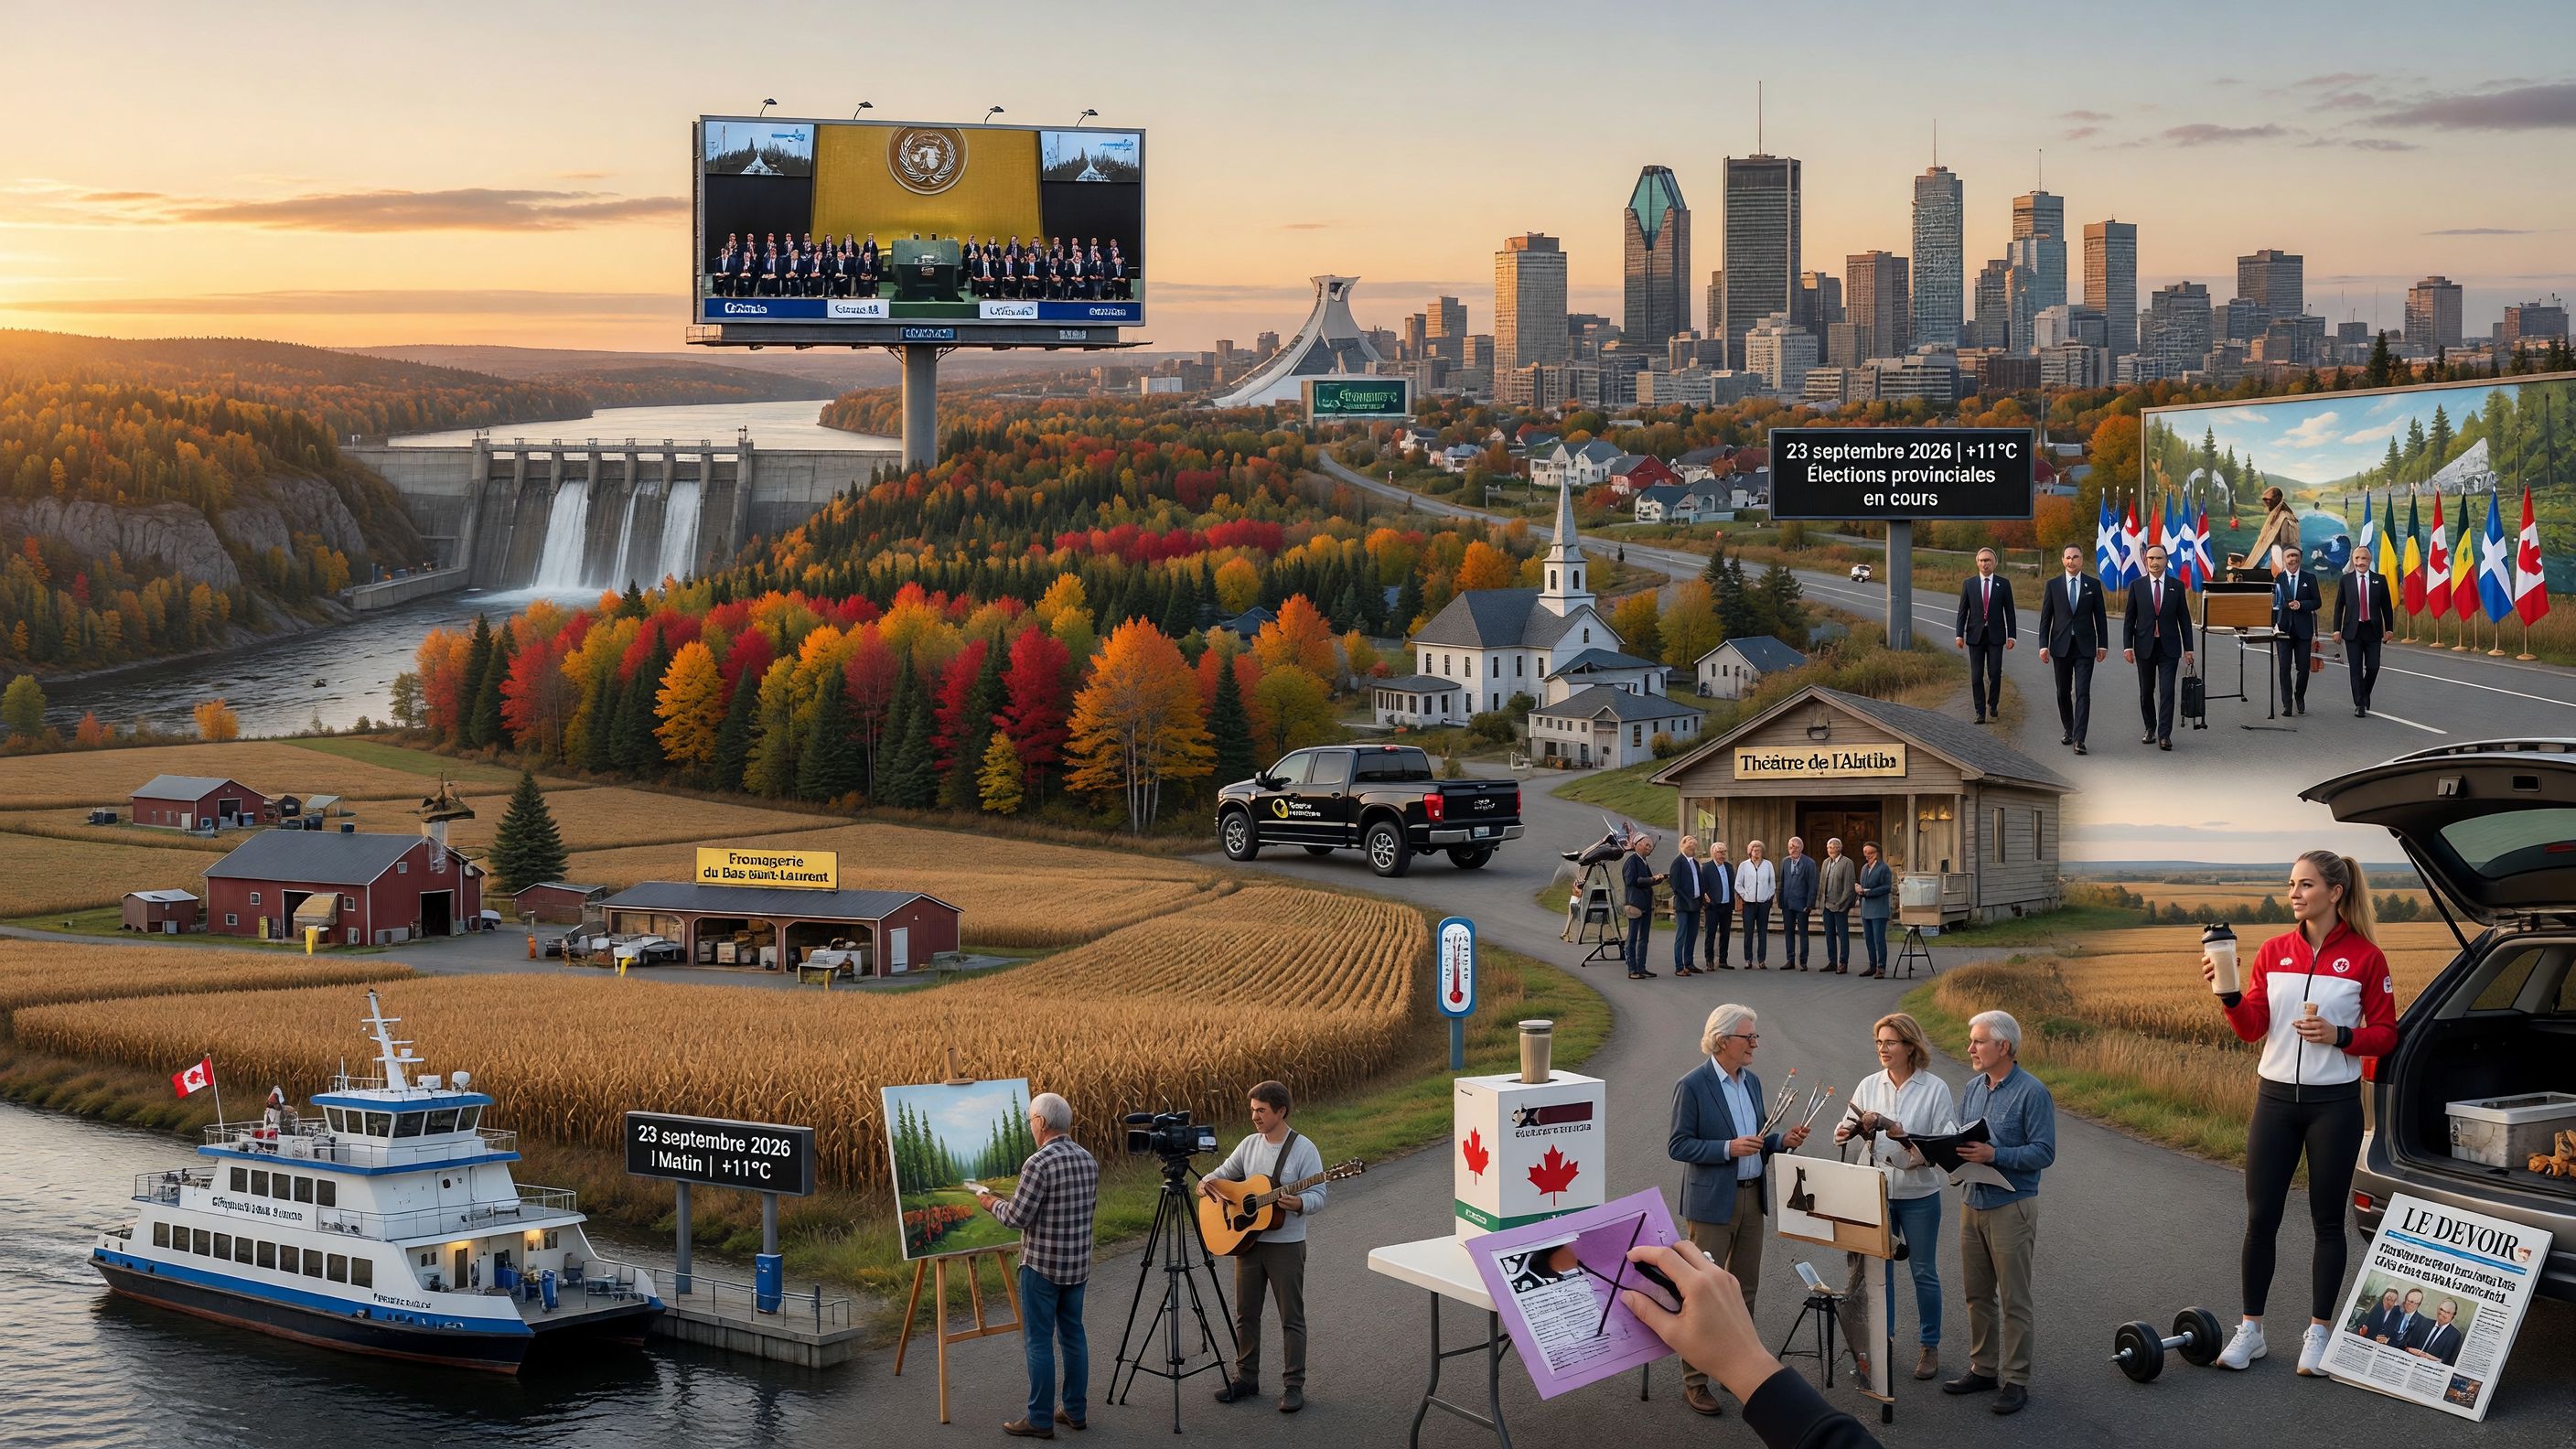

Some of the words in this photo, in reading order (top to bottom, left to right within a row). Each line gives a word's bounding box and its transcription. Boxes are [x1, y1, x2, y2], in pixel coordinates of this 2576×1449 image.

[1787, 443, 1808, 459] 23
[1813, 443, 1905, 463] septembre
[1909, 443, 1951, 459] 2026
[1966, 443, 2018, 459] +11°C
[1807, 463, 1886, 483] Élections
[1892, 466, 1996, 487] provinciales
[1863, 493, 1884, 506] en
[1890, 493, 1938, 506] cours
[1740, 754, 1805, 771] Théâtre
[1808, 754, 1829, 769] de
[729, 853, 804, 868] Fromagerie
[703, 866, 718, 878] du
[723, 867, 746, 879] Bas
[638, 1125, 658, 1143] 23
[661, 1130, 746, 1152] septembre
[750, 1136, 791, 1157] 2026
[659, 1151, 703, 1172] Matin
[722, 1159, 771, 1179] +11°C
[2401, 1207, 2433, 1235] LE
[2433, 1215, 2519, 1261] DEVOIR
